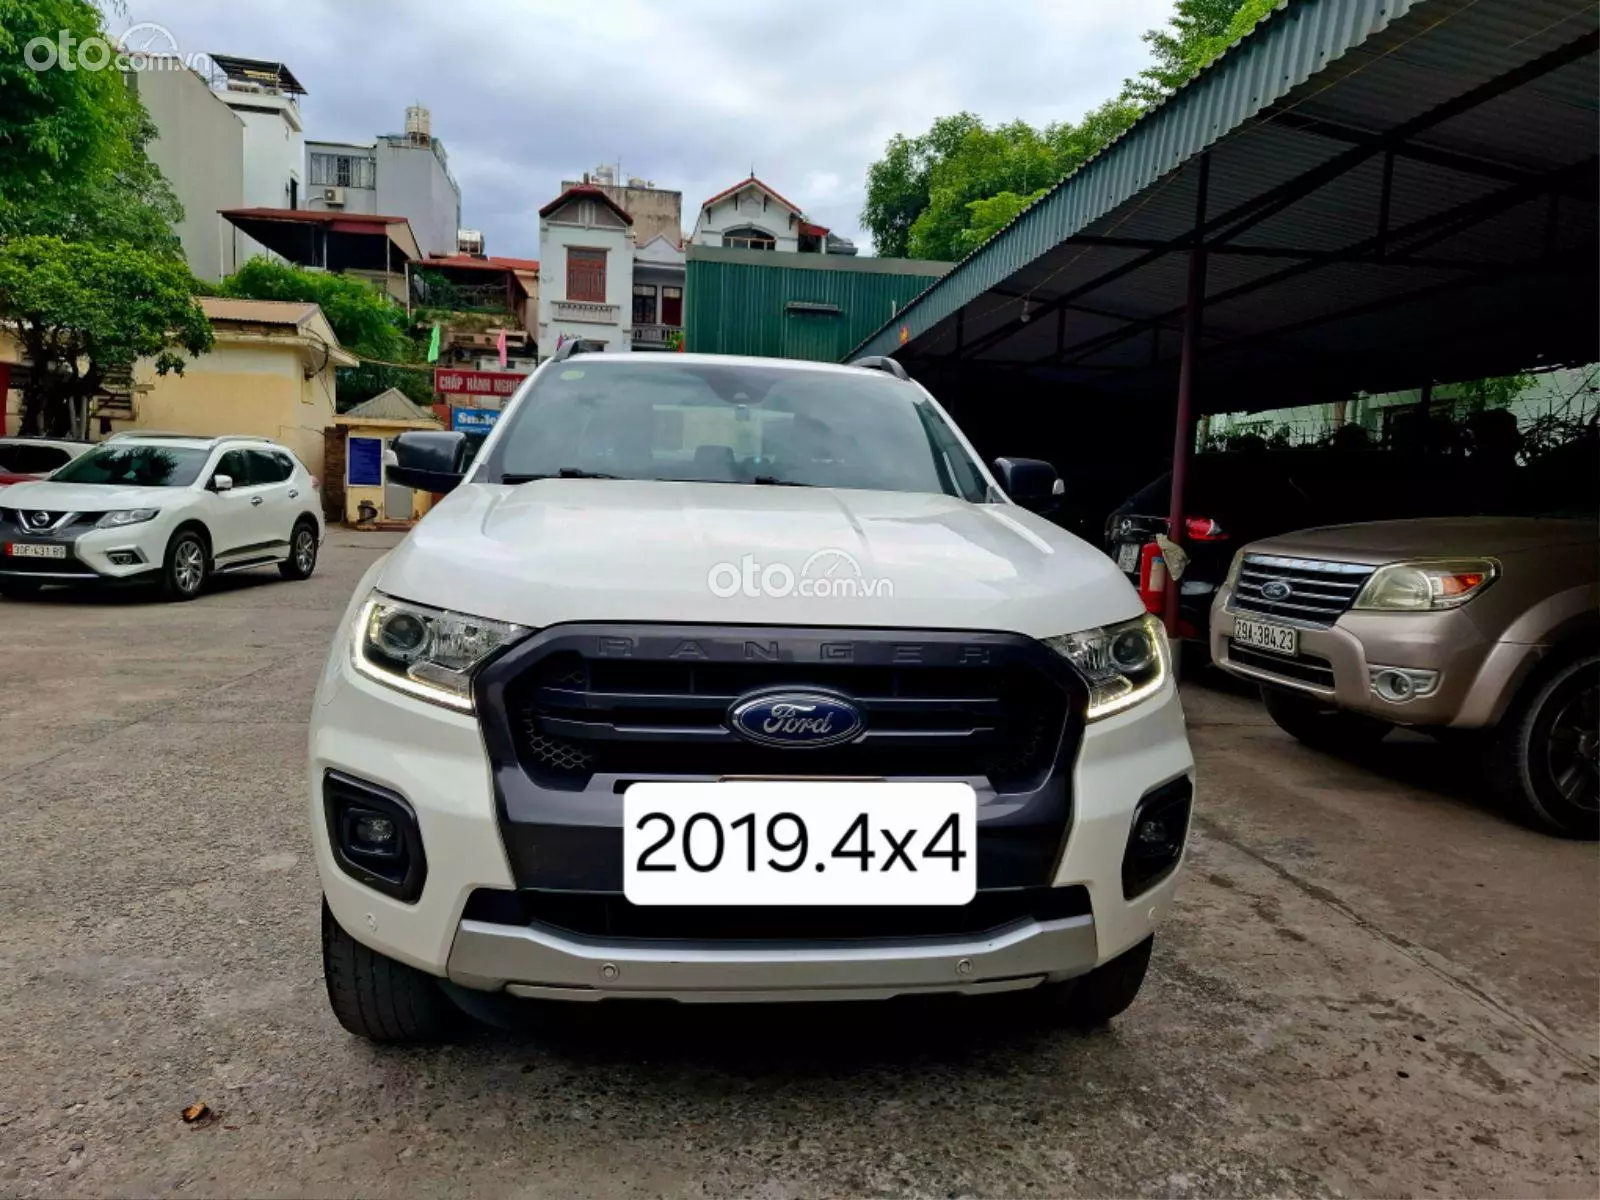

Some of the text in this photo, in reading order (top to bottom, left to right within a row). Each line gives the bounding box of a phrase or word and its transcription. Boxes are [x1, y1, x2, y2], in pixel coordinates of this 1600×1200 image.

[439, 373, 463, 390] CHẤP
[467, 374, 491, 392] HÀNH
[598, 635, 990, 663] RANGER
[763, 703, 832, 734] Ford
